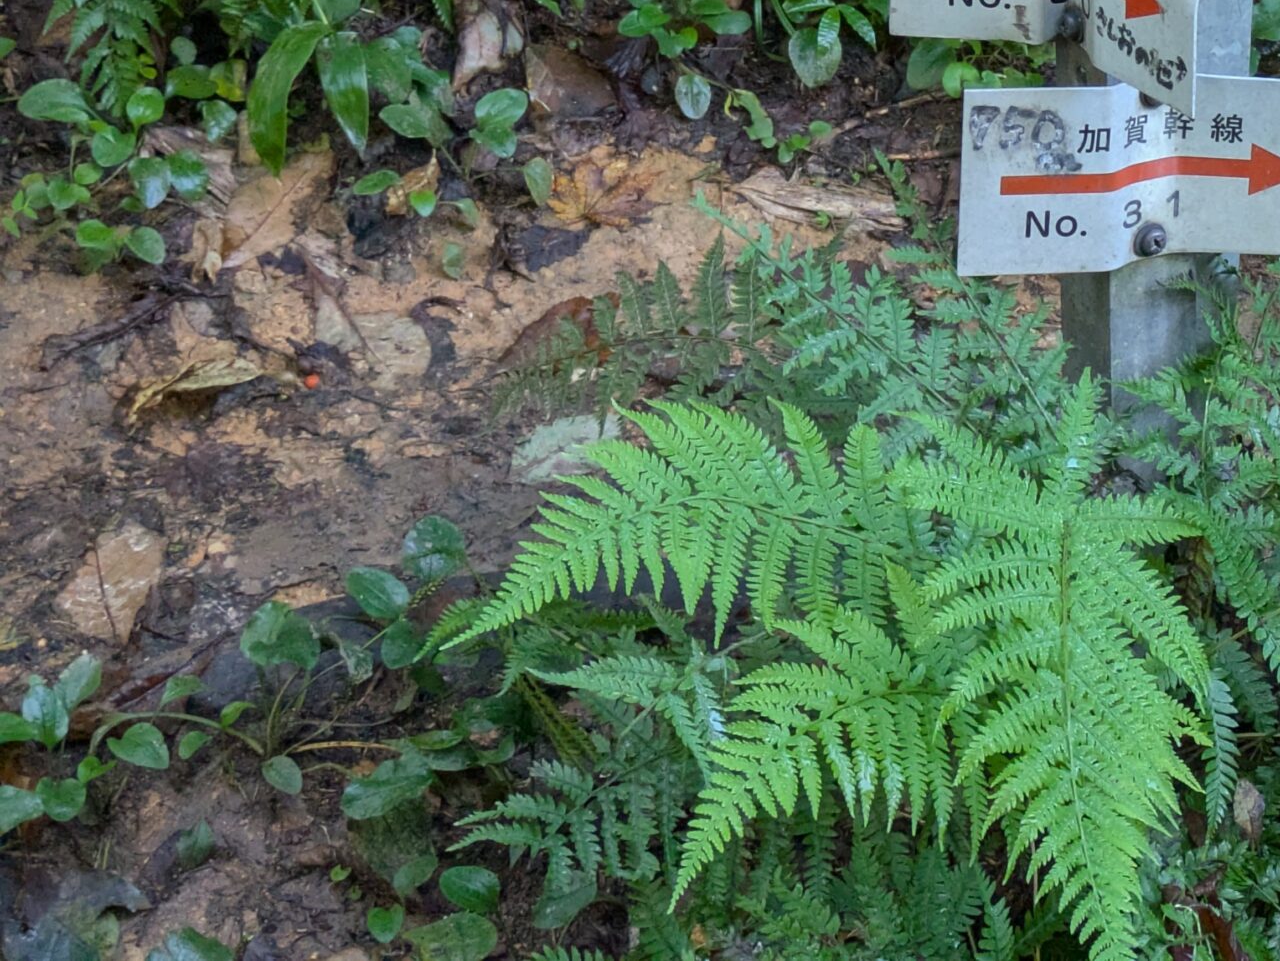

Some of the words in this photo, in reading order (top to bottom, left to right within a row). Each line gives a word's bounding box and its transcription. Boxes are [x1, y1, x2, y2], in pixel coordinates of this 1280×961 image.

[1077, 108, 1243, 154] 加賀幹線
[1025, 209, 1087, 238] No.
